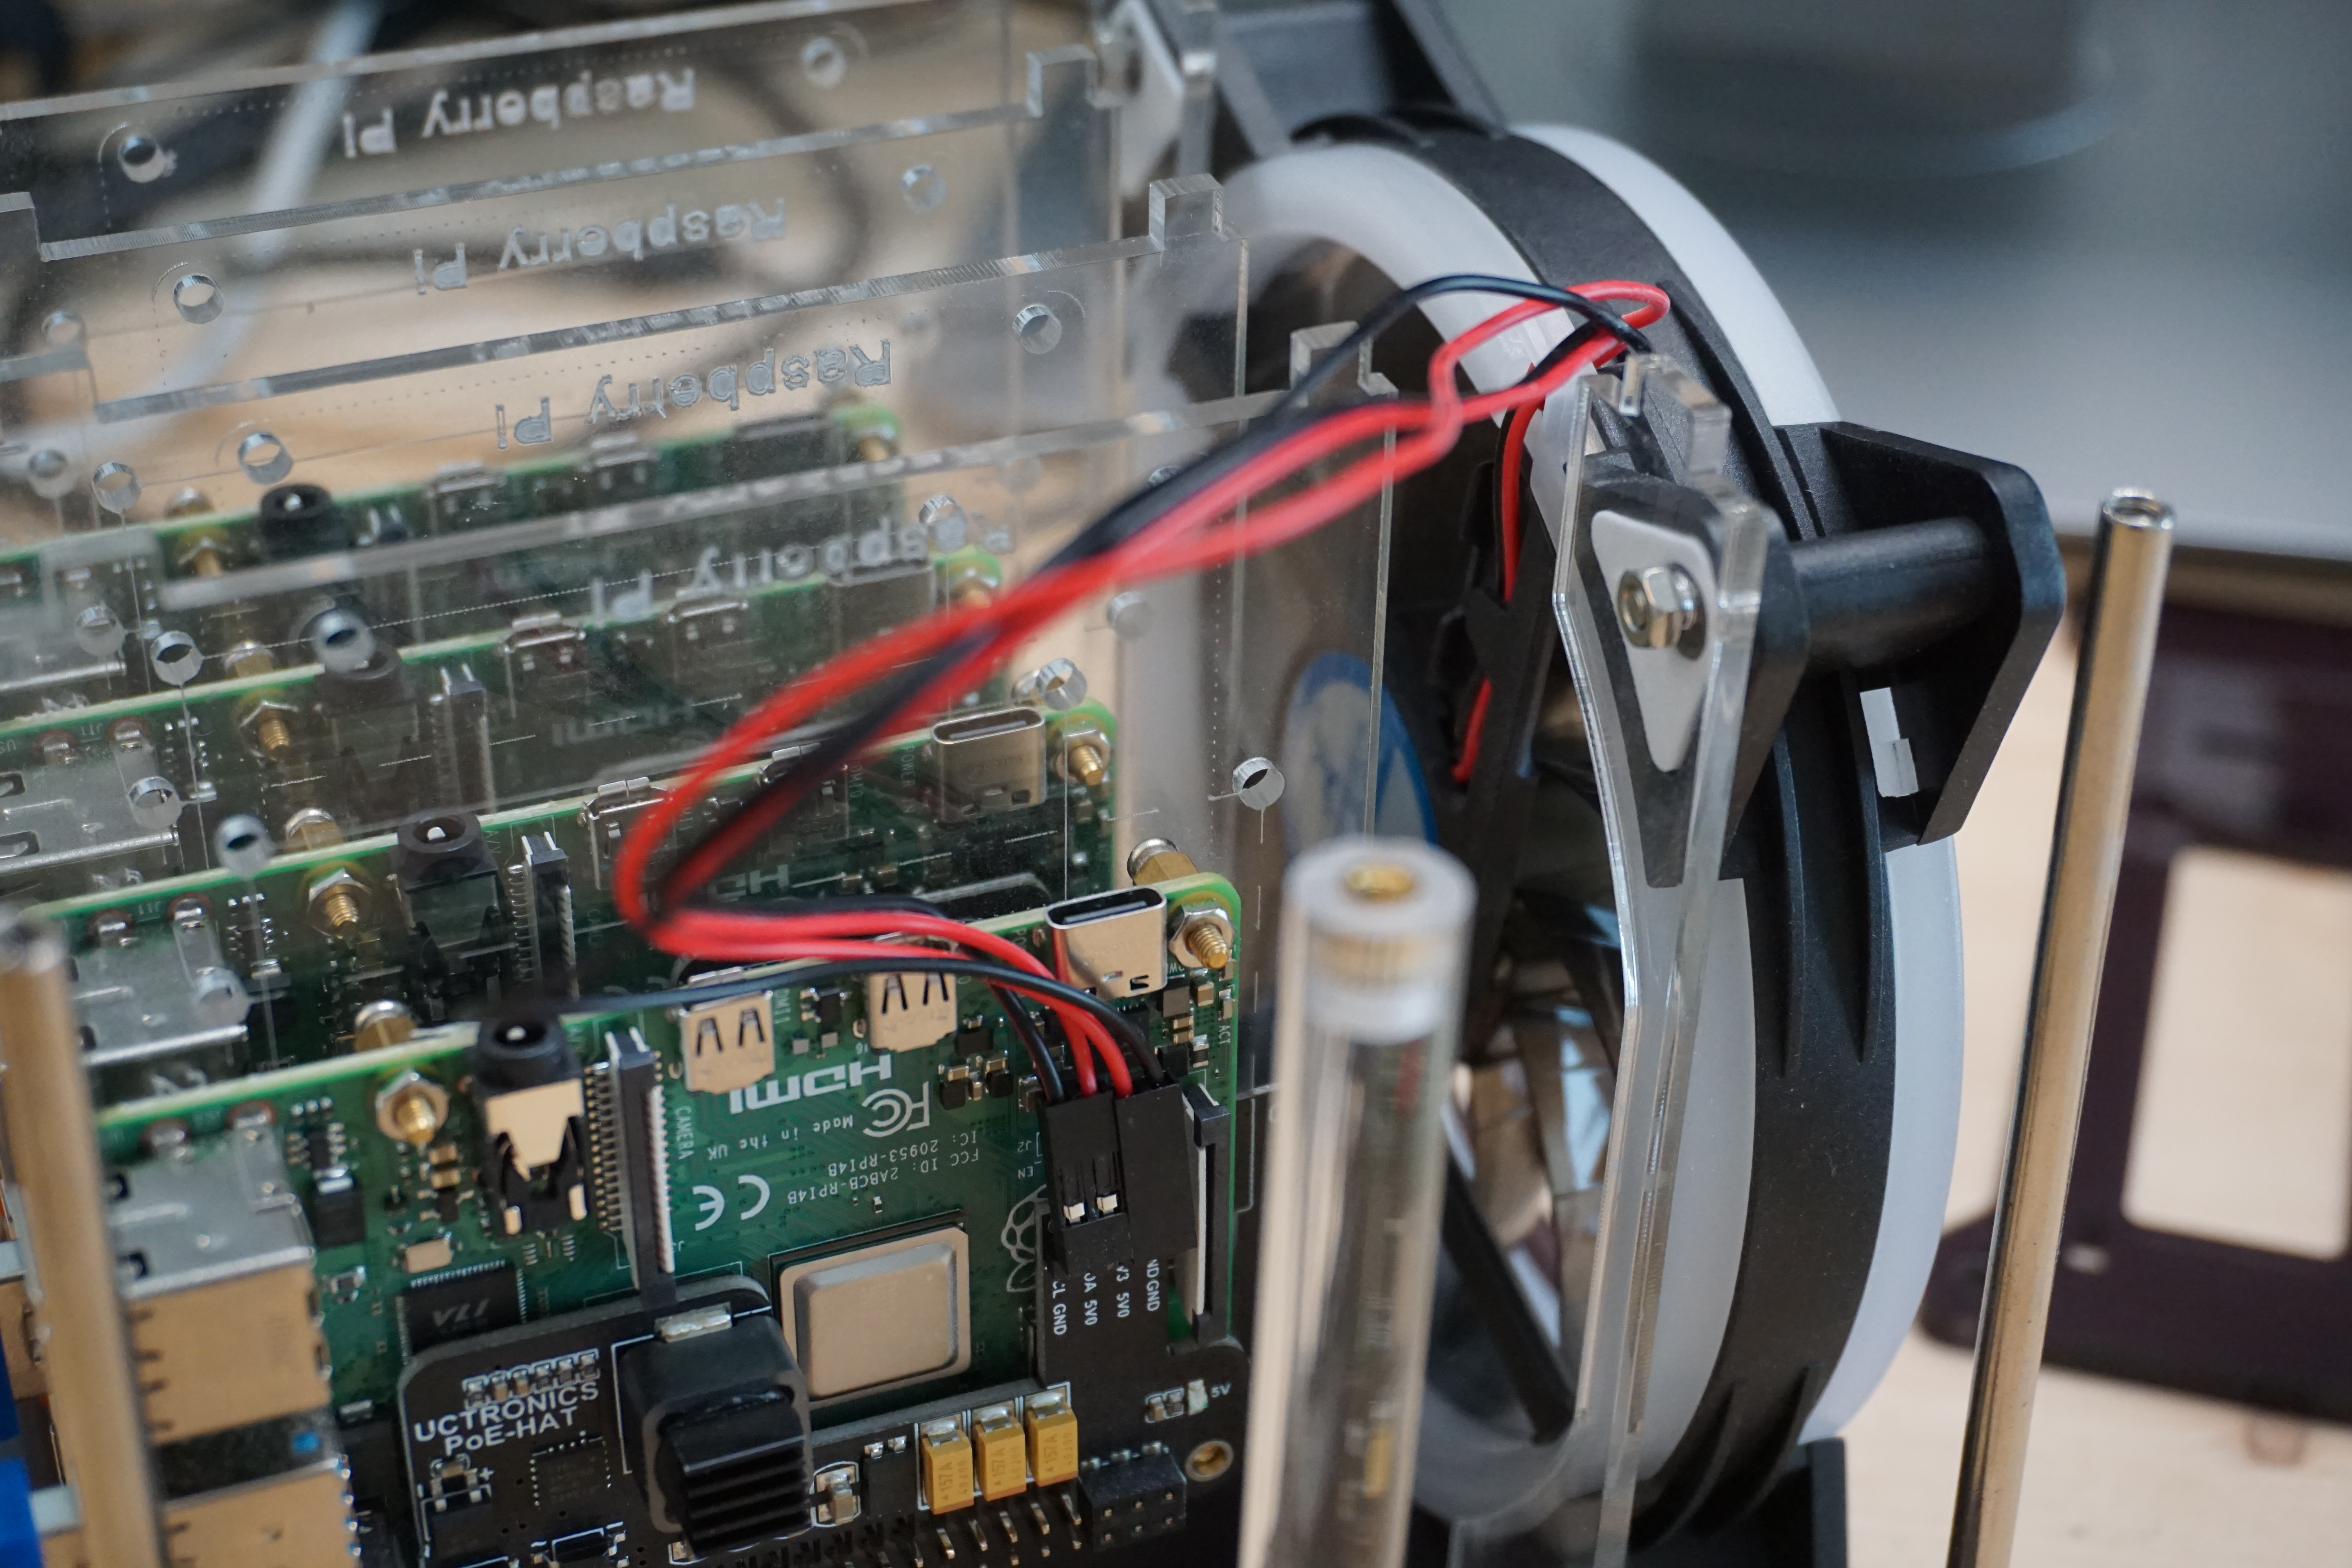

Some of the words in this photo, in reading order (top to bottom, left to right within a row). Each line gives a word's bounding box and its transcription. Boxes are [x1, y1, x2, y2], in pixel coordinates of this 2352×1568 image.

[421, 68, 695, 138] Raspberry
[497, 198, 785, 271] Raspberry
[584, 339, 891, 424] Raspberry
[495, 397, 552, 450] Pi
[730, 1054, 892, 1114] HDMI
[675, 1106, 695, 1160] CAMERA
[739, 1135, 768, 1150] the
[781, 1127, 799, 1140] in
[813, 1115, 854, 1134] Made
[707, 1144, 728, 1160] UK
[828, 1139, 939, 1177] 20953-RPI4B
[950, 1149, 980, 1167] FCC
[787, 1166, 899, 1205] 2ABCB-RPI4B
[1146, 1279, 1160, 1311] GND
[1053, 1303, 1067, 1335] GND
[1210, 1382, 1231, 1398] 5V
[414, 1381, 599, 1442] UCTRONICS
[445, 1406, 579, 1456] PoE-HAT
